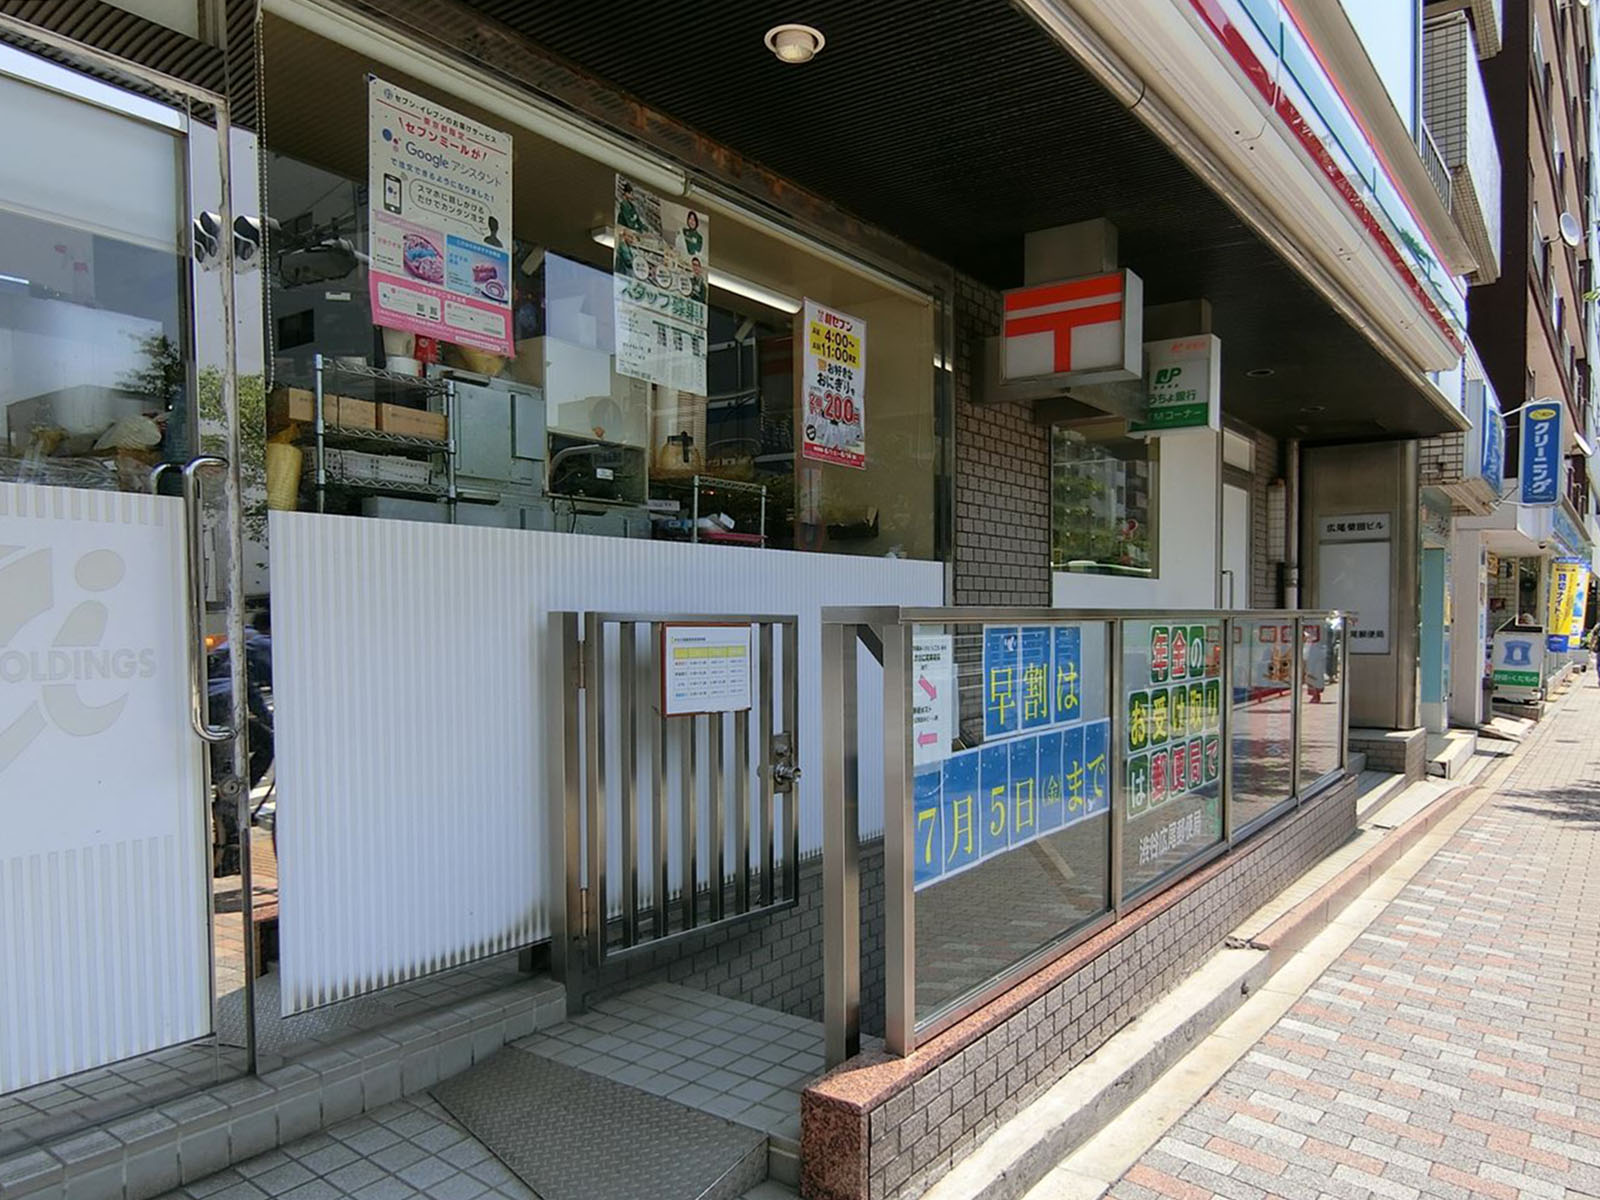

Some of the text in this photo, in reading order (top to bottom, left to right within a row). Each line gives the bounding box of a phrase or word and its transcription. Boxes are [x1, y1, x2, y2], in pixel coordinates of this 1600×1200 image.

[405, 141, 449, 169] Google
[1532, 421, 1552, 494] クリーニング
[1151, 628, 1205, 682] 年金の
[988, 662, 1081, 725] 早割は
[1131, 687, 1220, 746] お受け取り
[1131, 738, 1220, 809] は郵便局で
